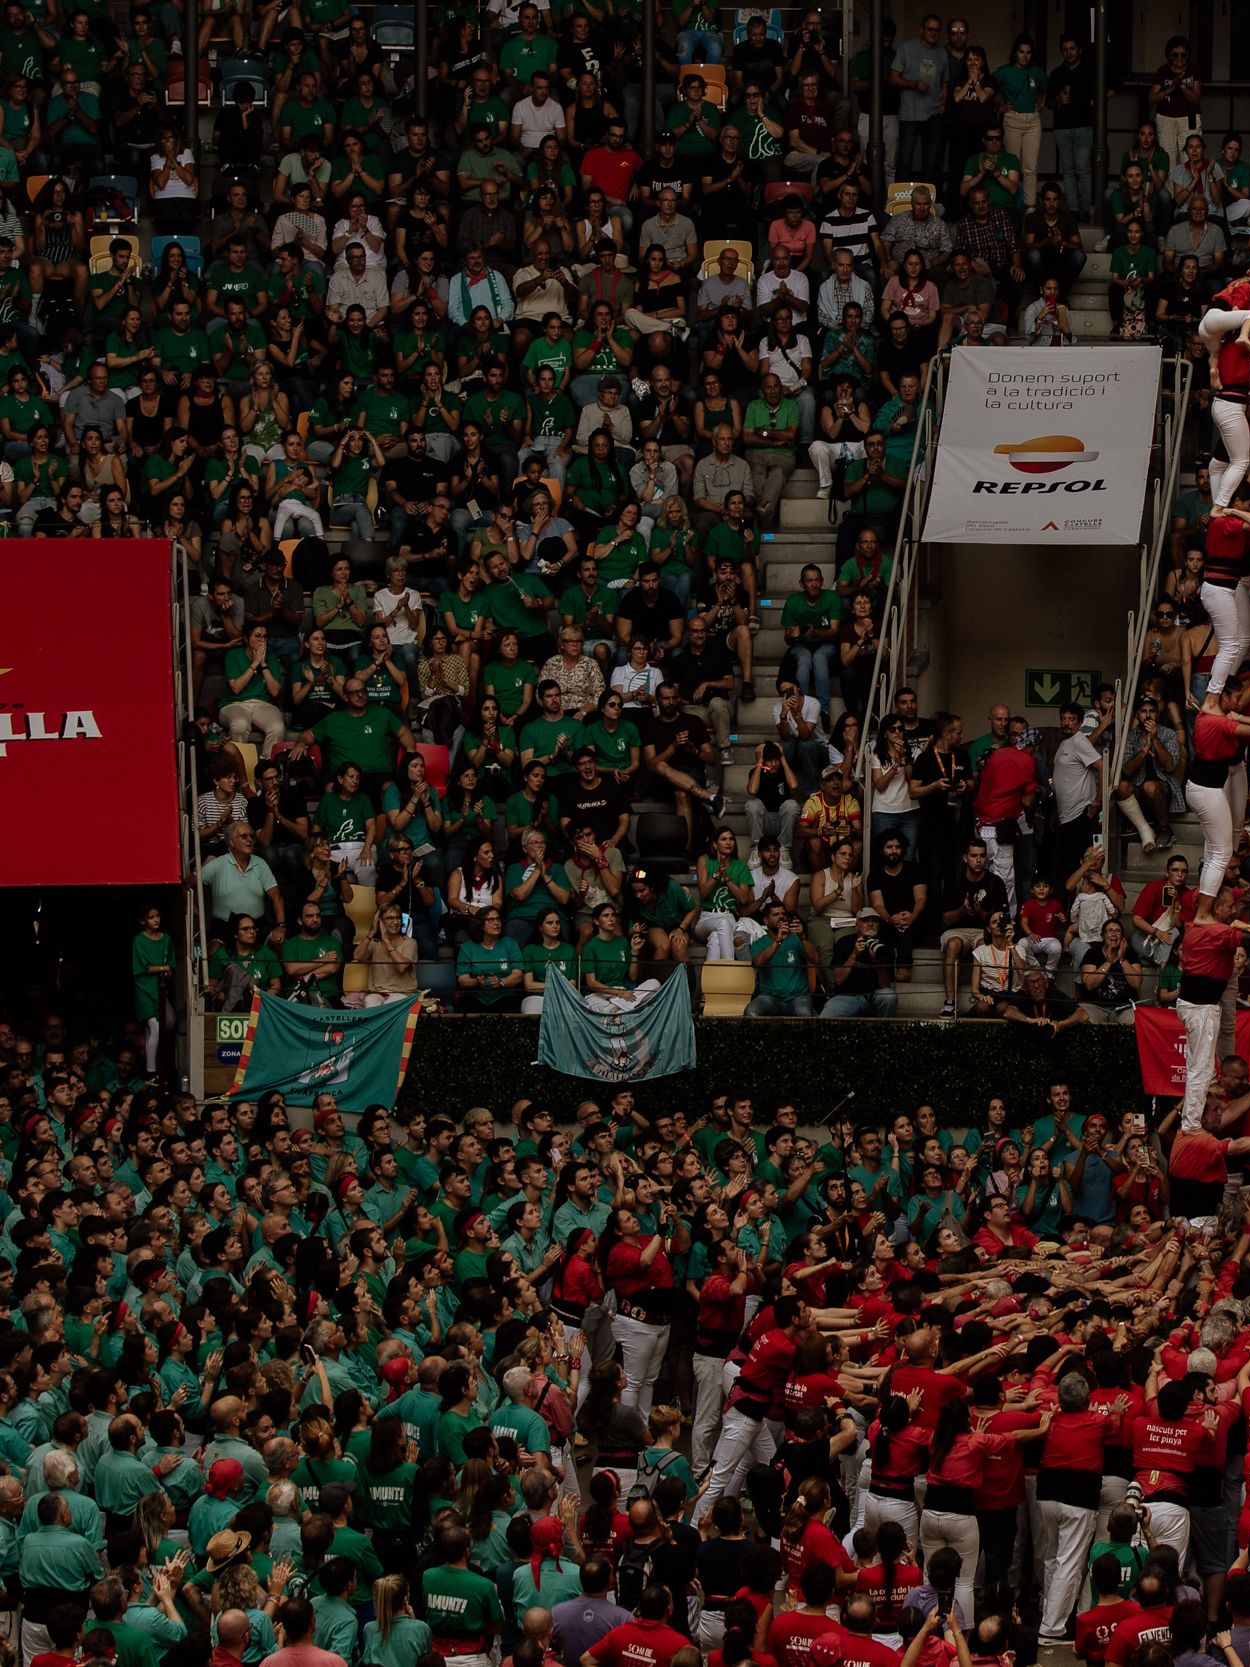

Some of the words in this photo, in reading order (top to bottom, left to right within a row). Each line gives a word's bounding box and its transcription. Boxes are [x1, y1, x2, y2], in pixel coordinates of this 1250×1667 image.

[988, 372, 1054, 383] Donem
[1060, 372, 1120, 385] suport
[986, 388, 997, 396] a
[1003, 386, 1020, 396] la
[1024, 386, 1095, 397] tradició
[1101, 387, 1105, 395] i
[985, 399, 1001, 409] la
[1007, 399, 1074, 410] cultura
[972, 479, 1107, 494] REPSOL
[1146, 1424, 1174, 1436] nascuts
[1175, 1428, 1187, 1437] per
[1149, 1434, 1161, 1443] fer
[1162, 1436, 1182, 1446] pinya
[898, 1586, 907, 1594] de
[428, 1593, 468, 1614] AMUNT!
[628, 1643, 646, 1656] SOM
[646, 1647, 653, 1658] DE
